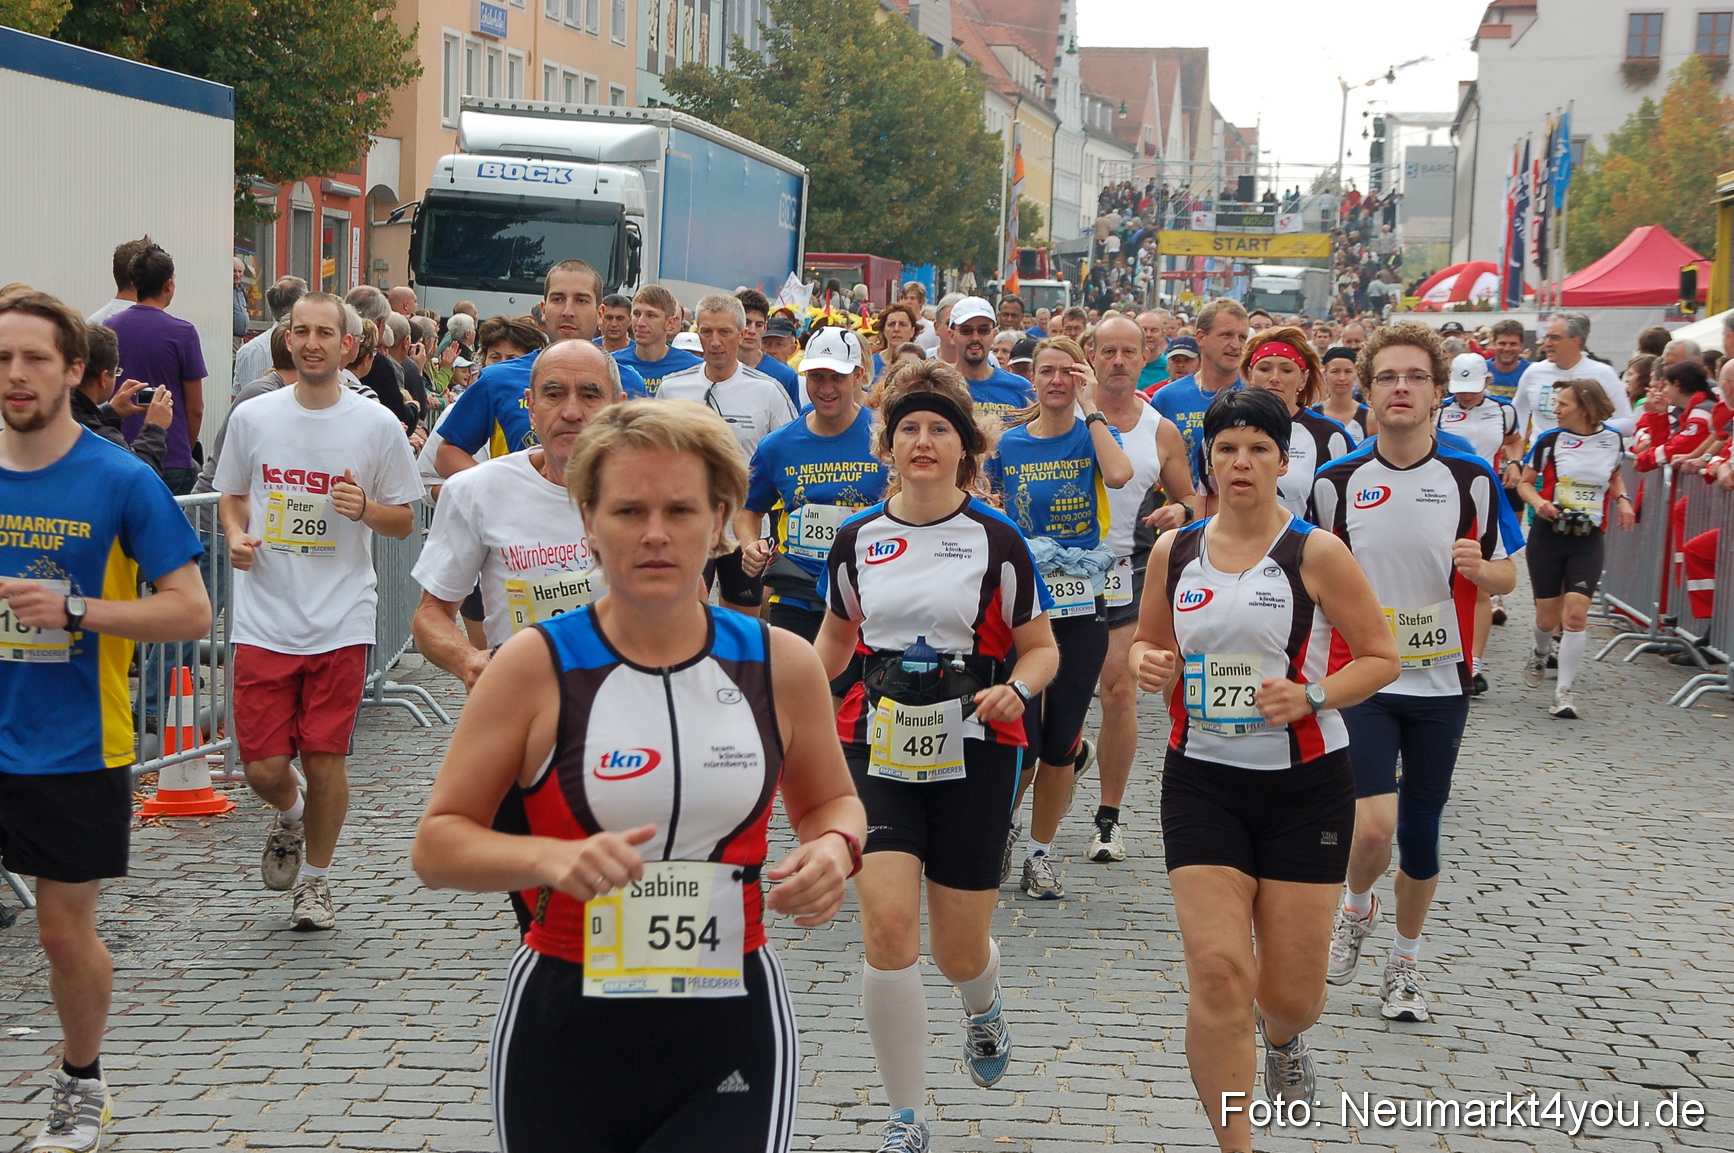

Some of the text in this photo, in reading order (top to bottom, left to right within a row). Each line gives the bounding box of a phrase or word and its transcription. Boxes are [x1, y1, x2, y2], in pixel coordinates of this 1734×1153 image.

[477, 162, 574, 185] BOCK
[1213, 237, 1272, 251] START
[785, 462, 878, 476] 10. NEUMARKTER
[1004, 458, 1091, 476] 10. NEUMARKTER
[797, 472, 862, 485] STADTLAUF
[1019, 470, 1079, 483] STADTLAUF
[1356, 489, 1380, 501] tkn
[1575, 491, 1596, 501] 352
[287, 499, 314, 512] Peter
[805, 509, 819, 519] Jan
[1050, 510, 1092, 522] 20.09.2009
[292, 518, 327, 535] 269
[805, 525, 841, 540] 283
[867, 542, 896, 556] tkn
[509, 542, 577, 571] Nürnberger
[533, 579, 592, 600] Herbert
[1046, 581, 1085, 598] 2839
[1180, 590, 1203, 603] tkn
[516, 611, 523, 623] D
[1399, 614, 1433, 625] Stefan
[1408, 628, 1447, 648] 449
[1210, 662, 1251, 676] Connie
[1212, 686, 1256, 707] 273
[895, 709, 944, 727] Manuela
[903, 733, 948, 756] 487
[601, 751, 642, 768] tkn
[703, 760, 748, 769] nürnberg
[631, 873, 699, 898] Sabine
[592, 917, 602, 934] D
[648, 915, 720, 951] 554
